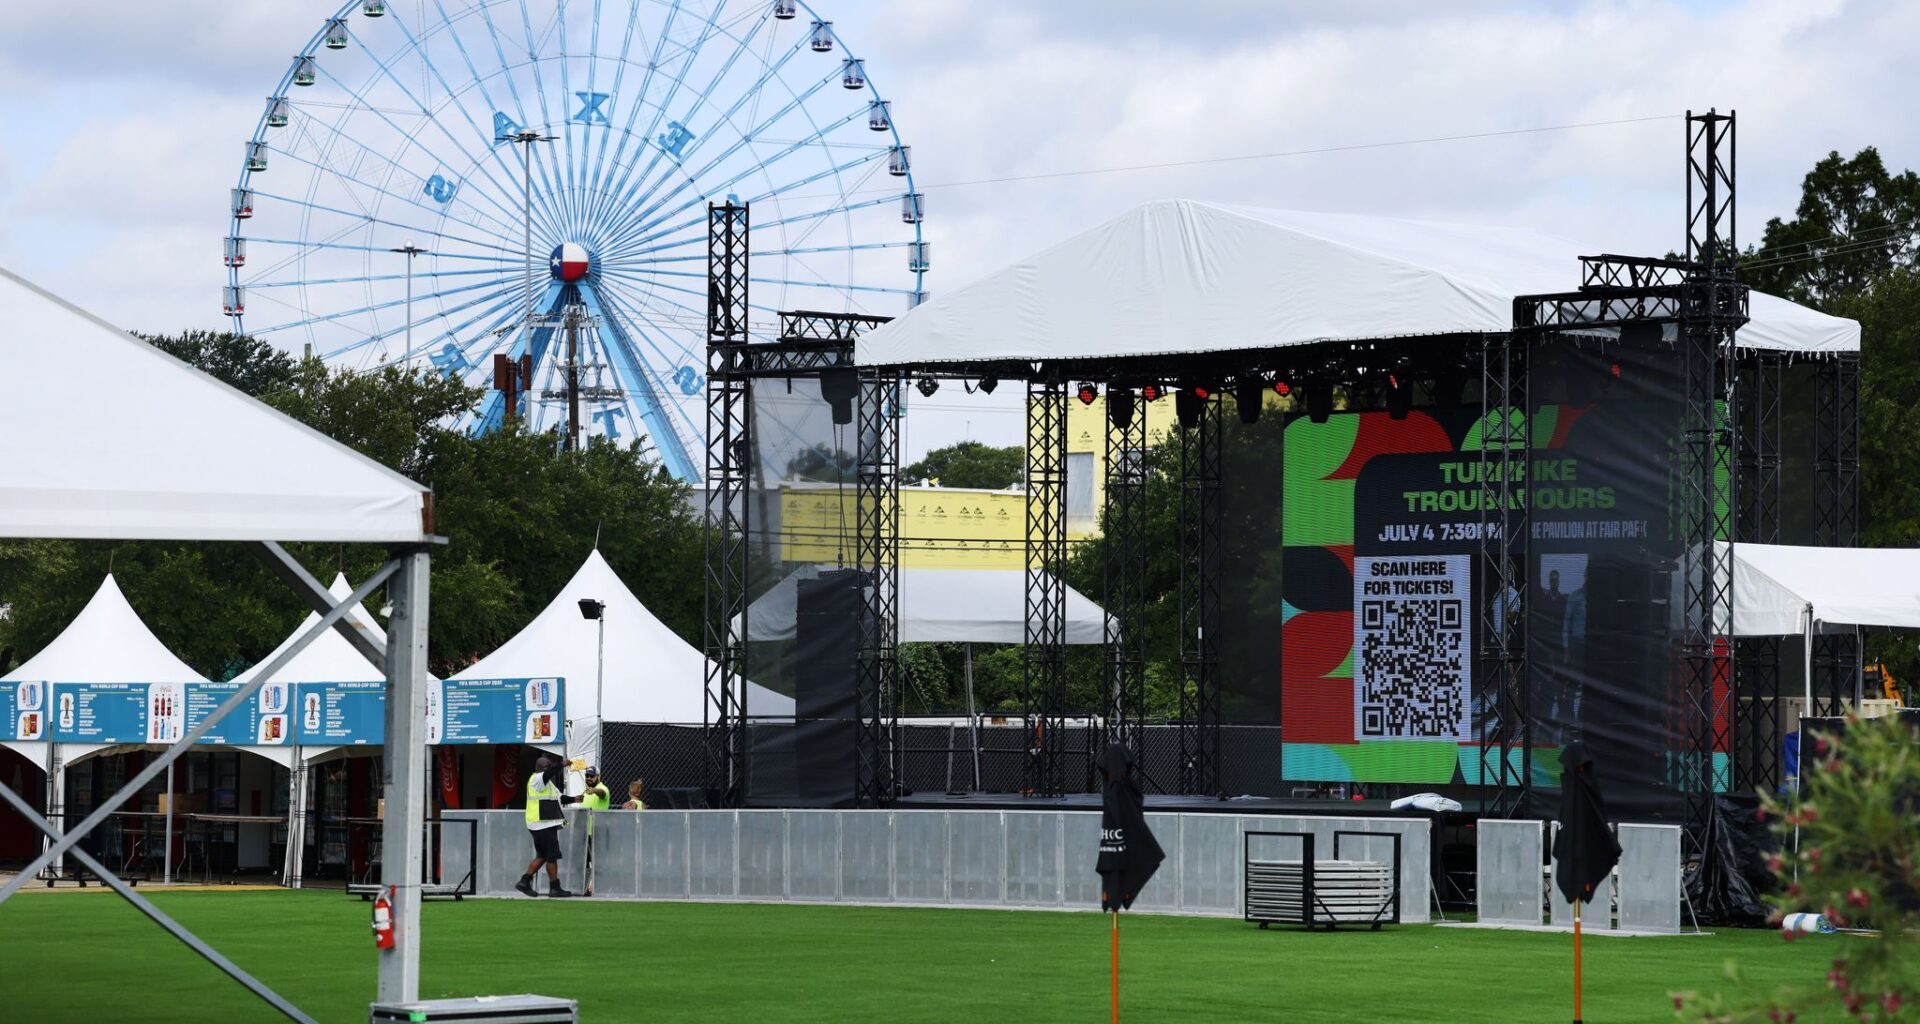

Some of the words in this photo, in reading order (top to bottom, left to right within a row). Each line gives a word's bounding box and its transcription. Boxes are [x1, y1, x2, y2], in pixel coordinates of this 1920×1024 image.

[1378, 524, 1420, 542] JULY
[1422, 524, 1435, 541] 4
[1543, 521, 1585, 539] PAVILION
[1585, 521, 1599, 539] AT
[1600, 521, 1622, 539] FAIR
[1371, 561, 1409, 576] SCAN
[1411, 561, 1447, 576] HERE
[1364, 580, 1391, 596] FOR
[1392, 580, 1454, 595] TICKETS!
